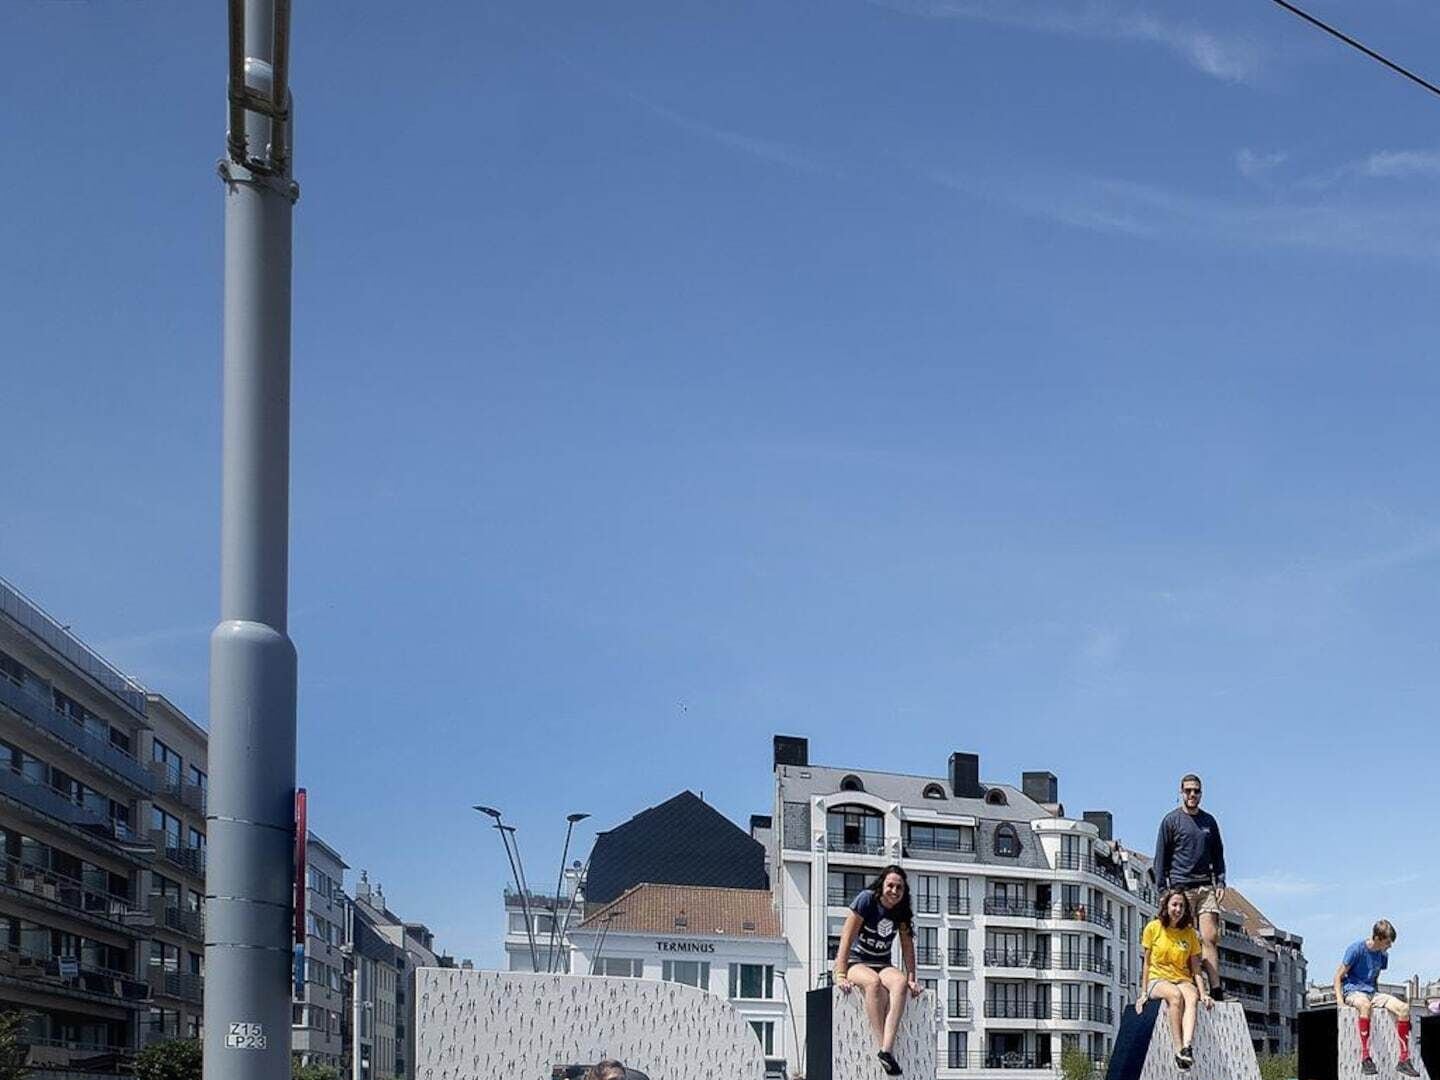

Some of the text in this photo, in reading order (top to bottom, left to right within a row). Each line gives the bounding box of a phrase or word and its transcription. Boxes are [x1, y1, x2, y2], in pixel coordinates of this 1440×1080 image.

[656, 941, 715, 953] TERMINUS
[231, 1023, 261, 1036] Z15
[226, 1036, 265, 1048] LP23
